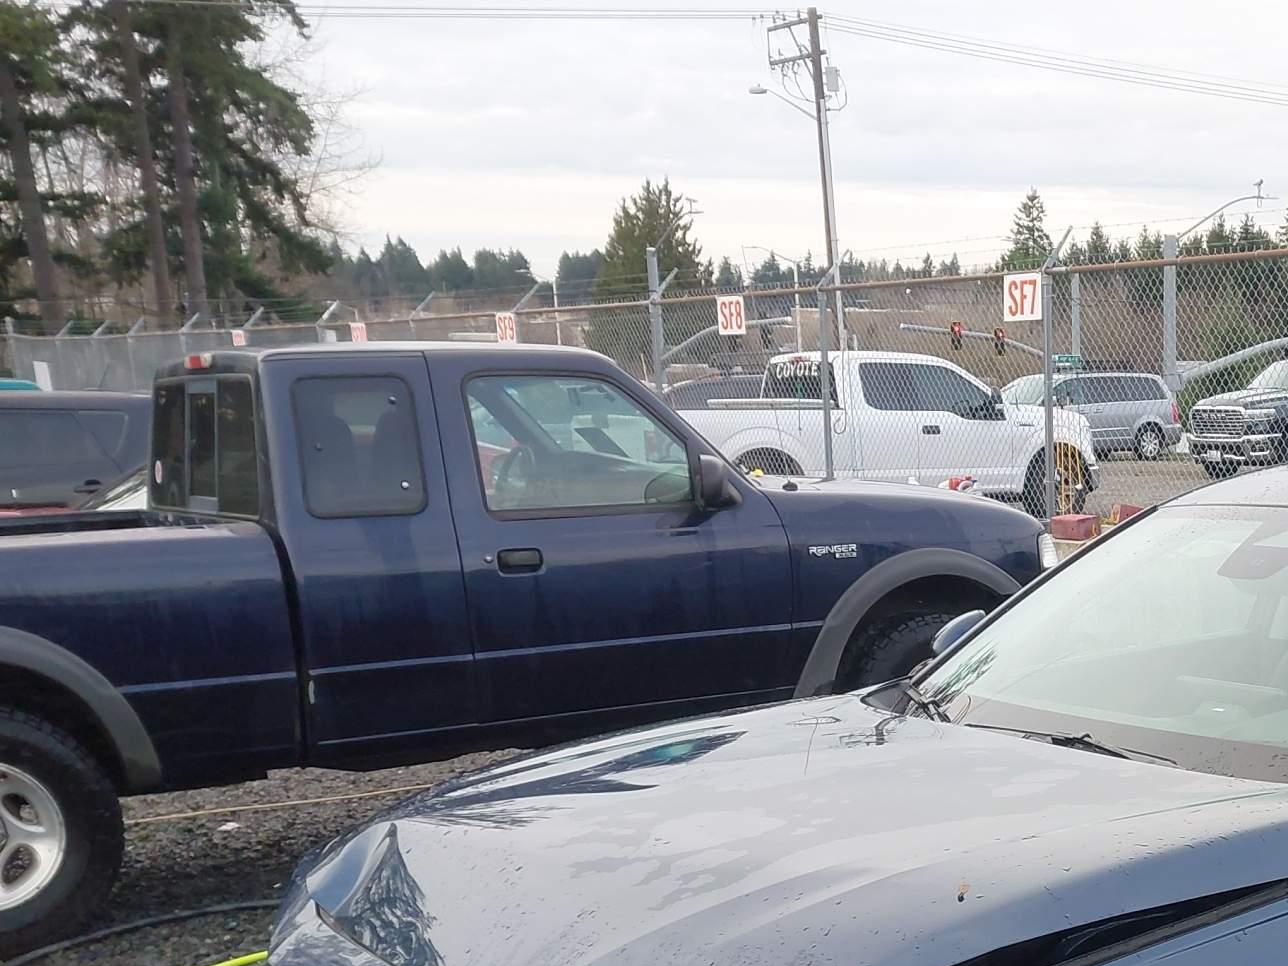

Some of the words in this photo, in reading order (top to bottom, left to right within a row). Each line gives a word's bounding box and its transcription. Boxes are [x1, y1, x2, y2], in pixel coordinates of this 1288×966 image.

[1008, 279, 1037, 317] SF7
[498, 316, 514, 341] SF9
[720, 300, 743, 330] SF8
[776, 361, 819, 379] COYOTE
